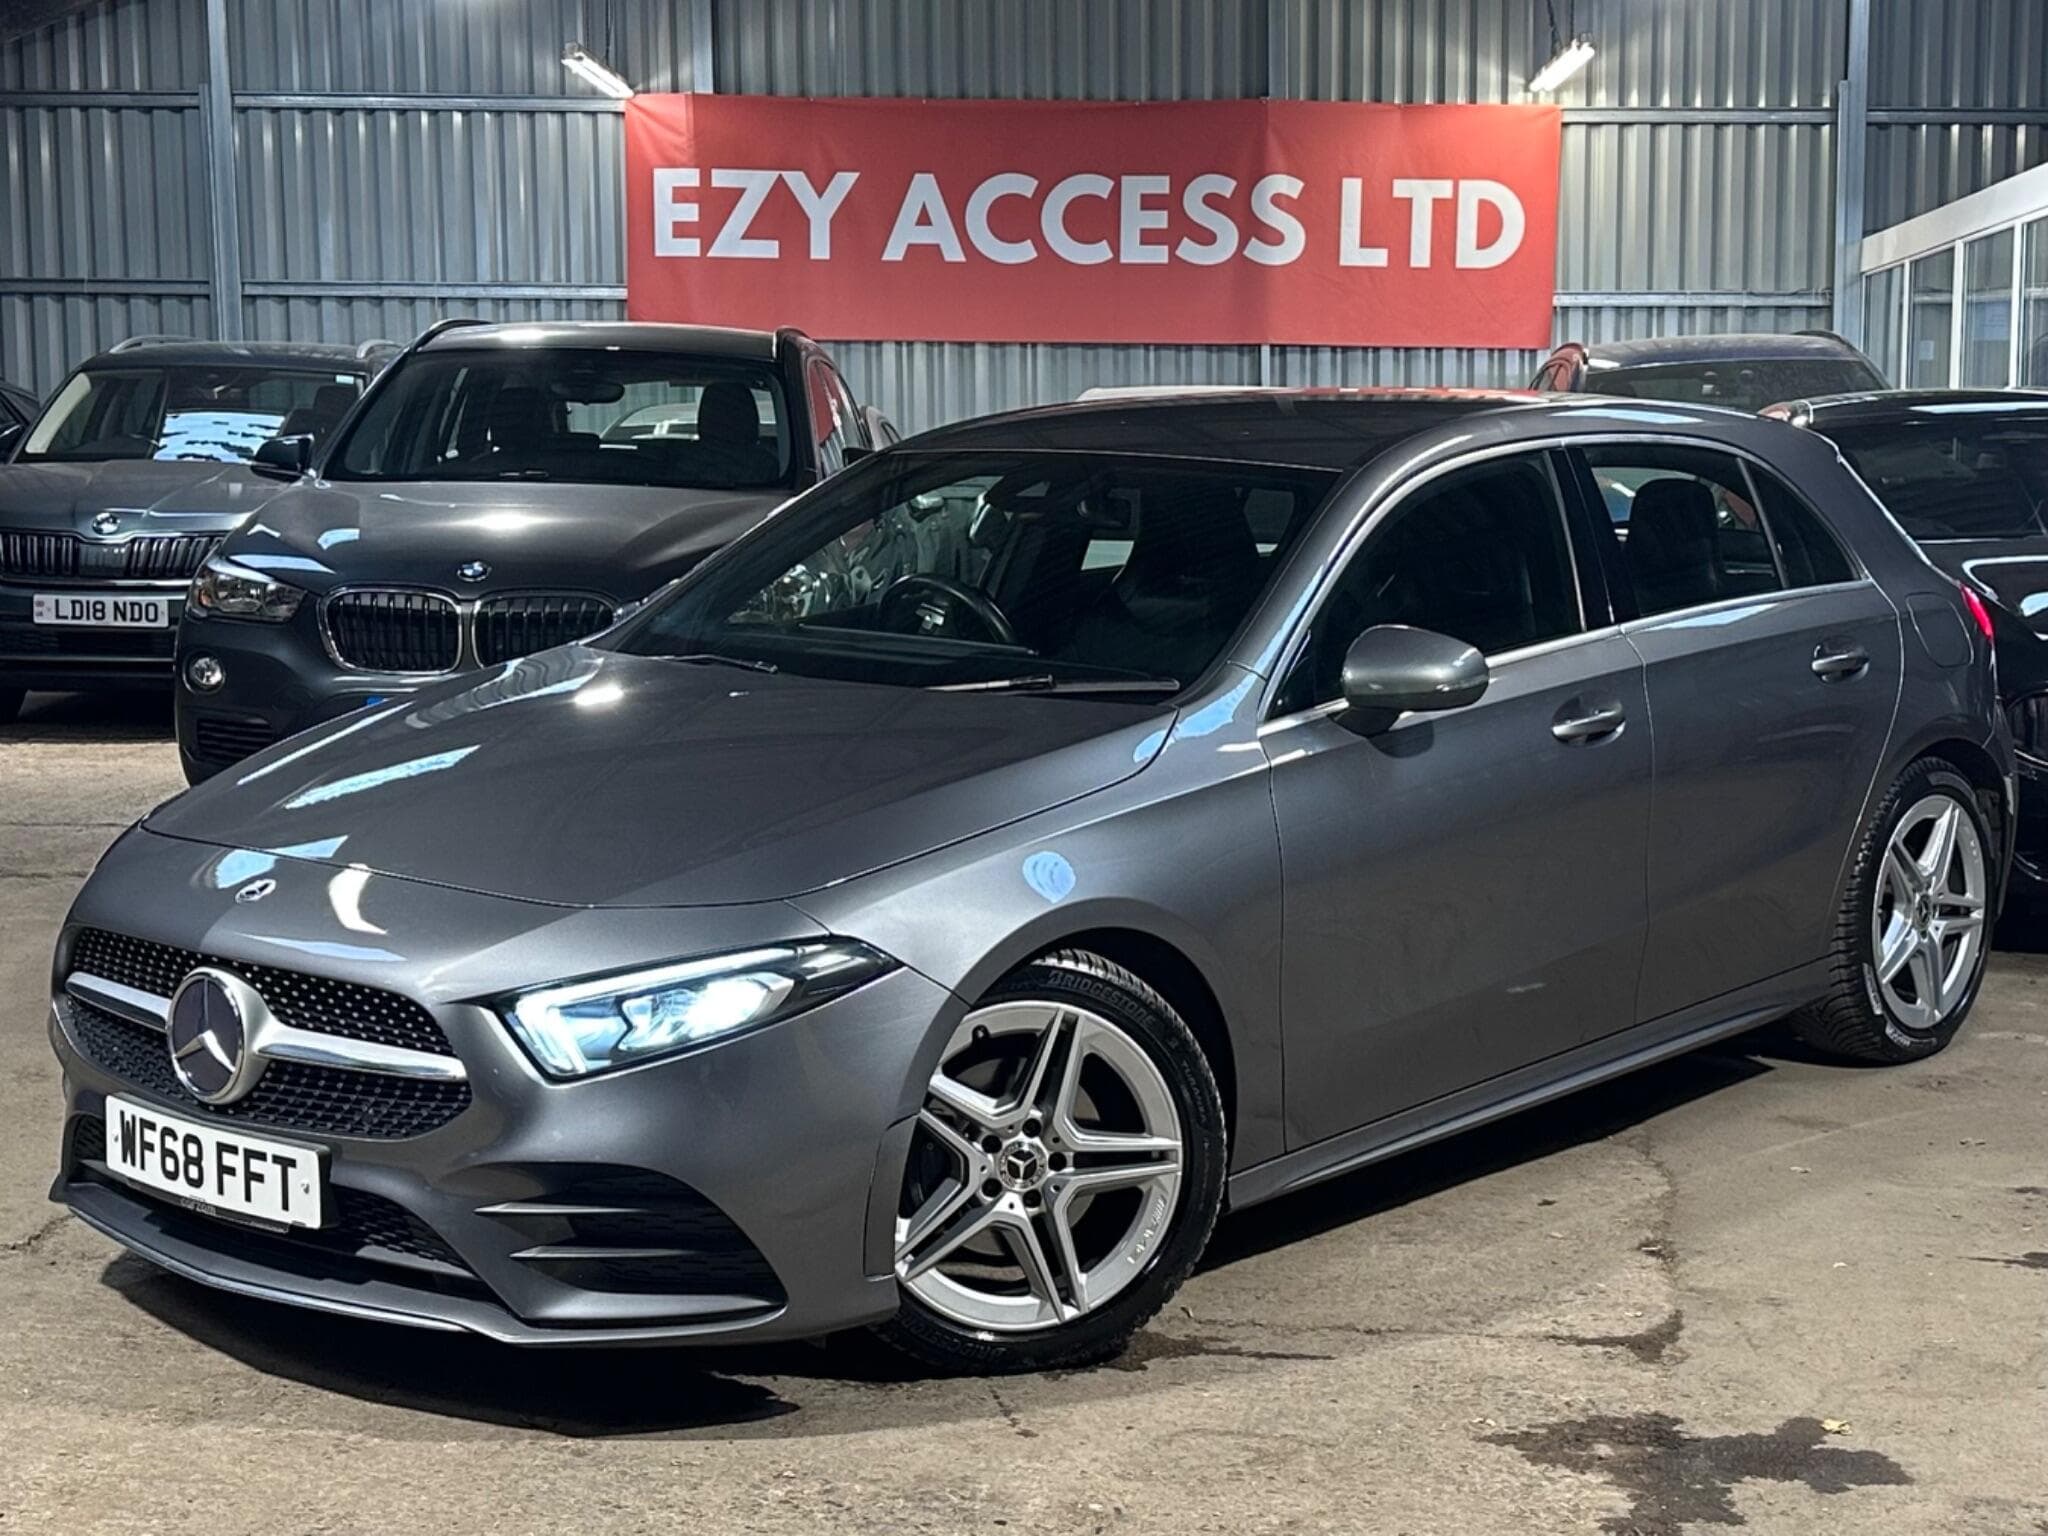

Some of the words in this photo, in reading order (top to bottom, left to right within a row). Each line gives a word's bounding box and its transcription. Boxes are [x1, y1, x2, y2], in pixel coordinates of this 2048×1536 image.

[653, 167, 860, 262] EZY
[881, 171, 1306, 267] ACCESS
[1339, 177, 1527, 270] LTD
[55, 598, 106, 621] LD18
[113, 601, 159, 623] NDO
[1046, 968, 1157, 1026] BRIDGESTONE
[119, 1109, 204, 1190] WF68
[215, 1140, 297, 1213] FFT
